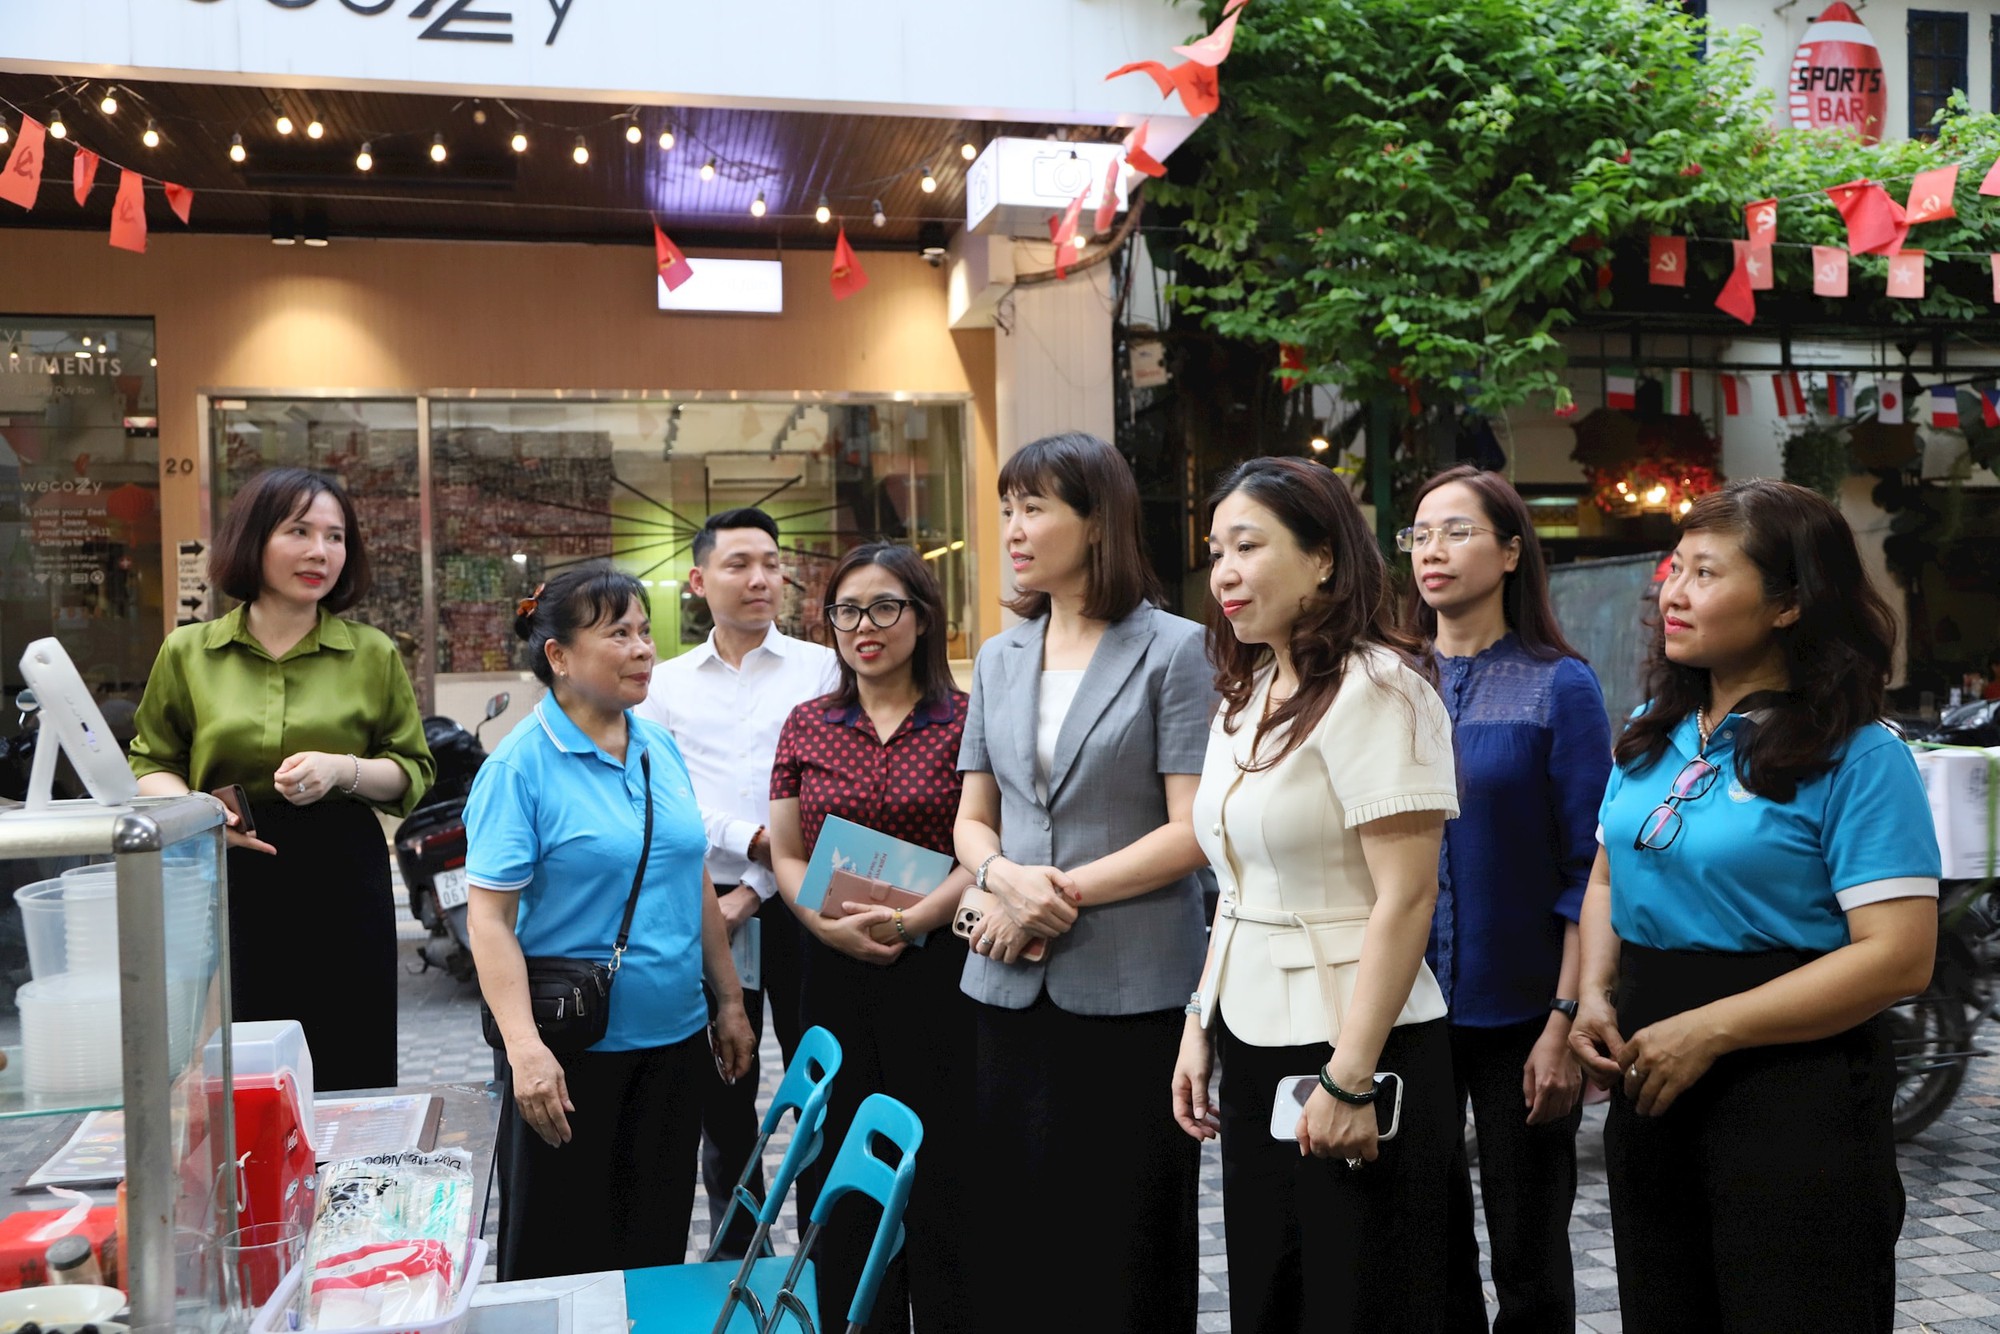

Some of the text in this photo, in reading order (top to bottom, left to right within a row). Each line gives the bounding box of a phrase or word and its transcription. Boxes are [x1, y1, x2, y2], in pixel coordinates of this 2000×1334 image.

[1797, 66, 1882, 93] SPORTS
[1817, 97, 1866, 123] BAR
[165, 458, 194, 475] 20
